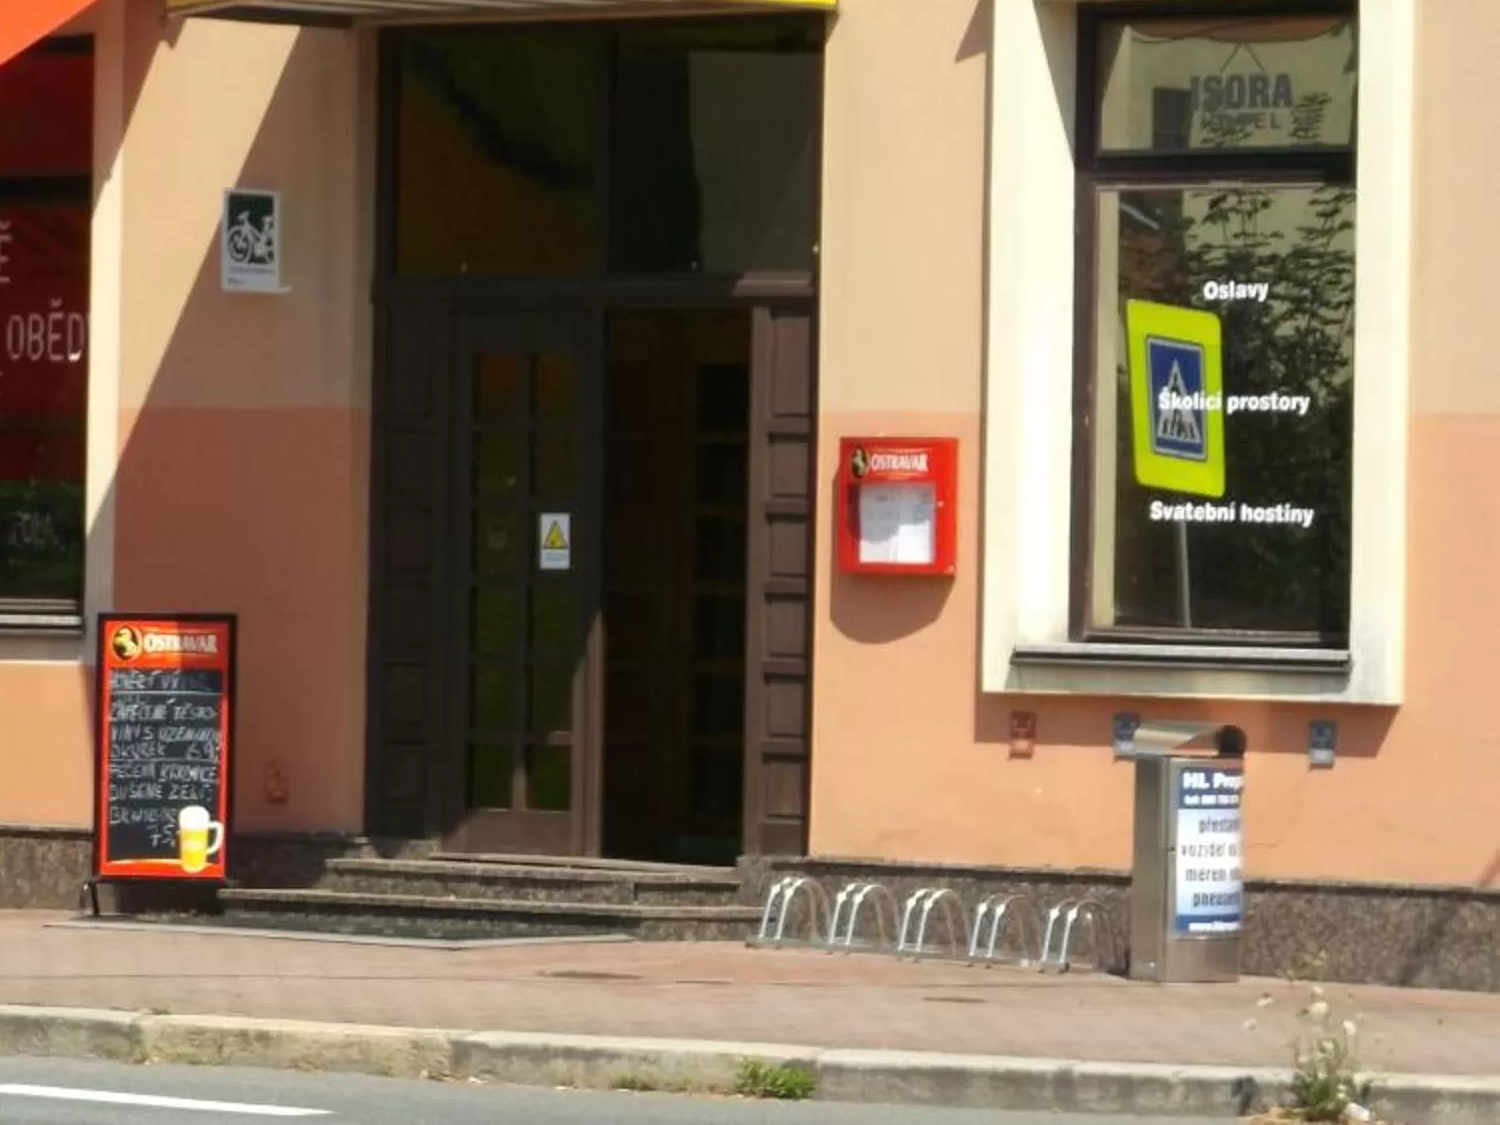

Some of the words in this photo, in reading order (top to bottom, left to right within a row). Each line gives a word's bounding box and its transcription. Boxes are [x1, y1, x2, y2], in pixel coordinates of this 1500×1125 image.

[1203, 280, 1269, 302] Oslavy
[6, 297, 88, 362] OBĚD
[1227, 392, 1311, 415] prostory
[871, 453, 928, 472] OSTRAVAR
[1150, 501, 1235, 522] Svatební
[1240, 503, 1315, 528] hostiny
[144, 634, 218, 653] OSTRAVAR
